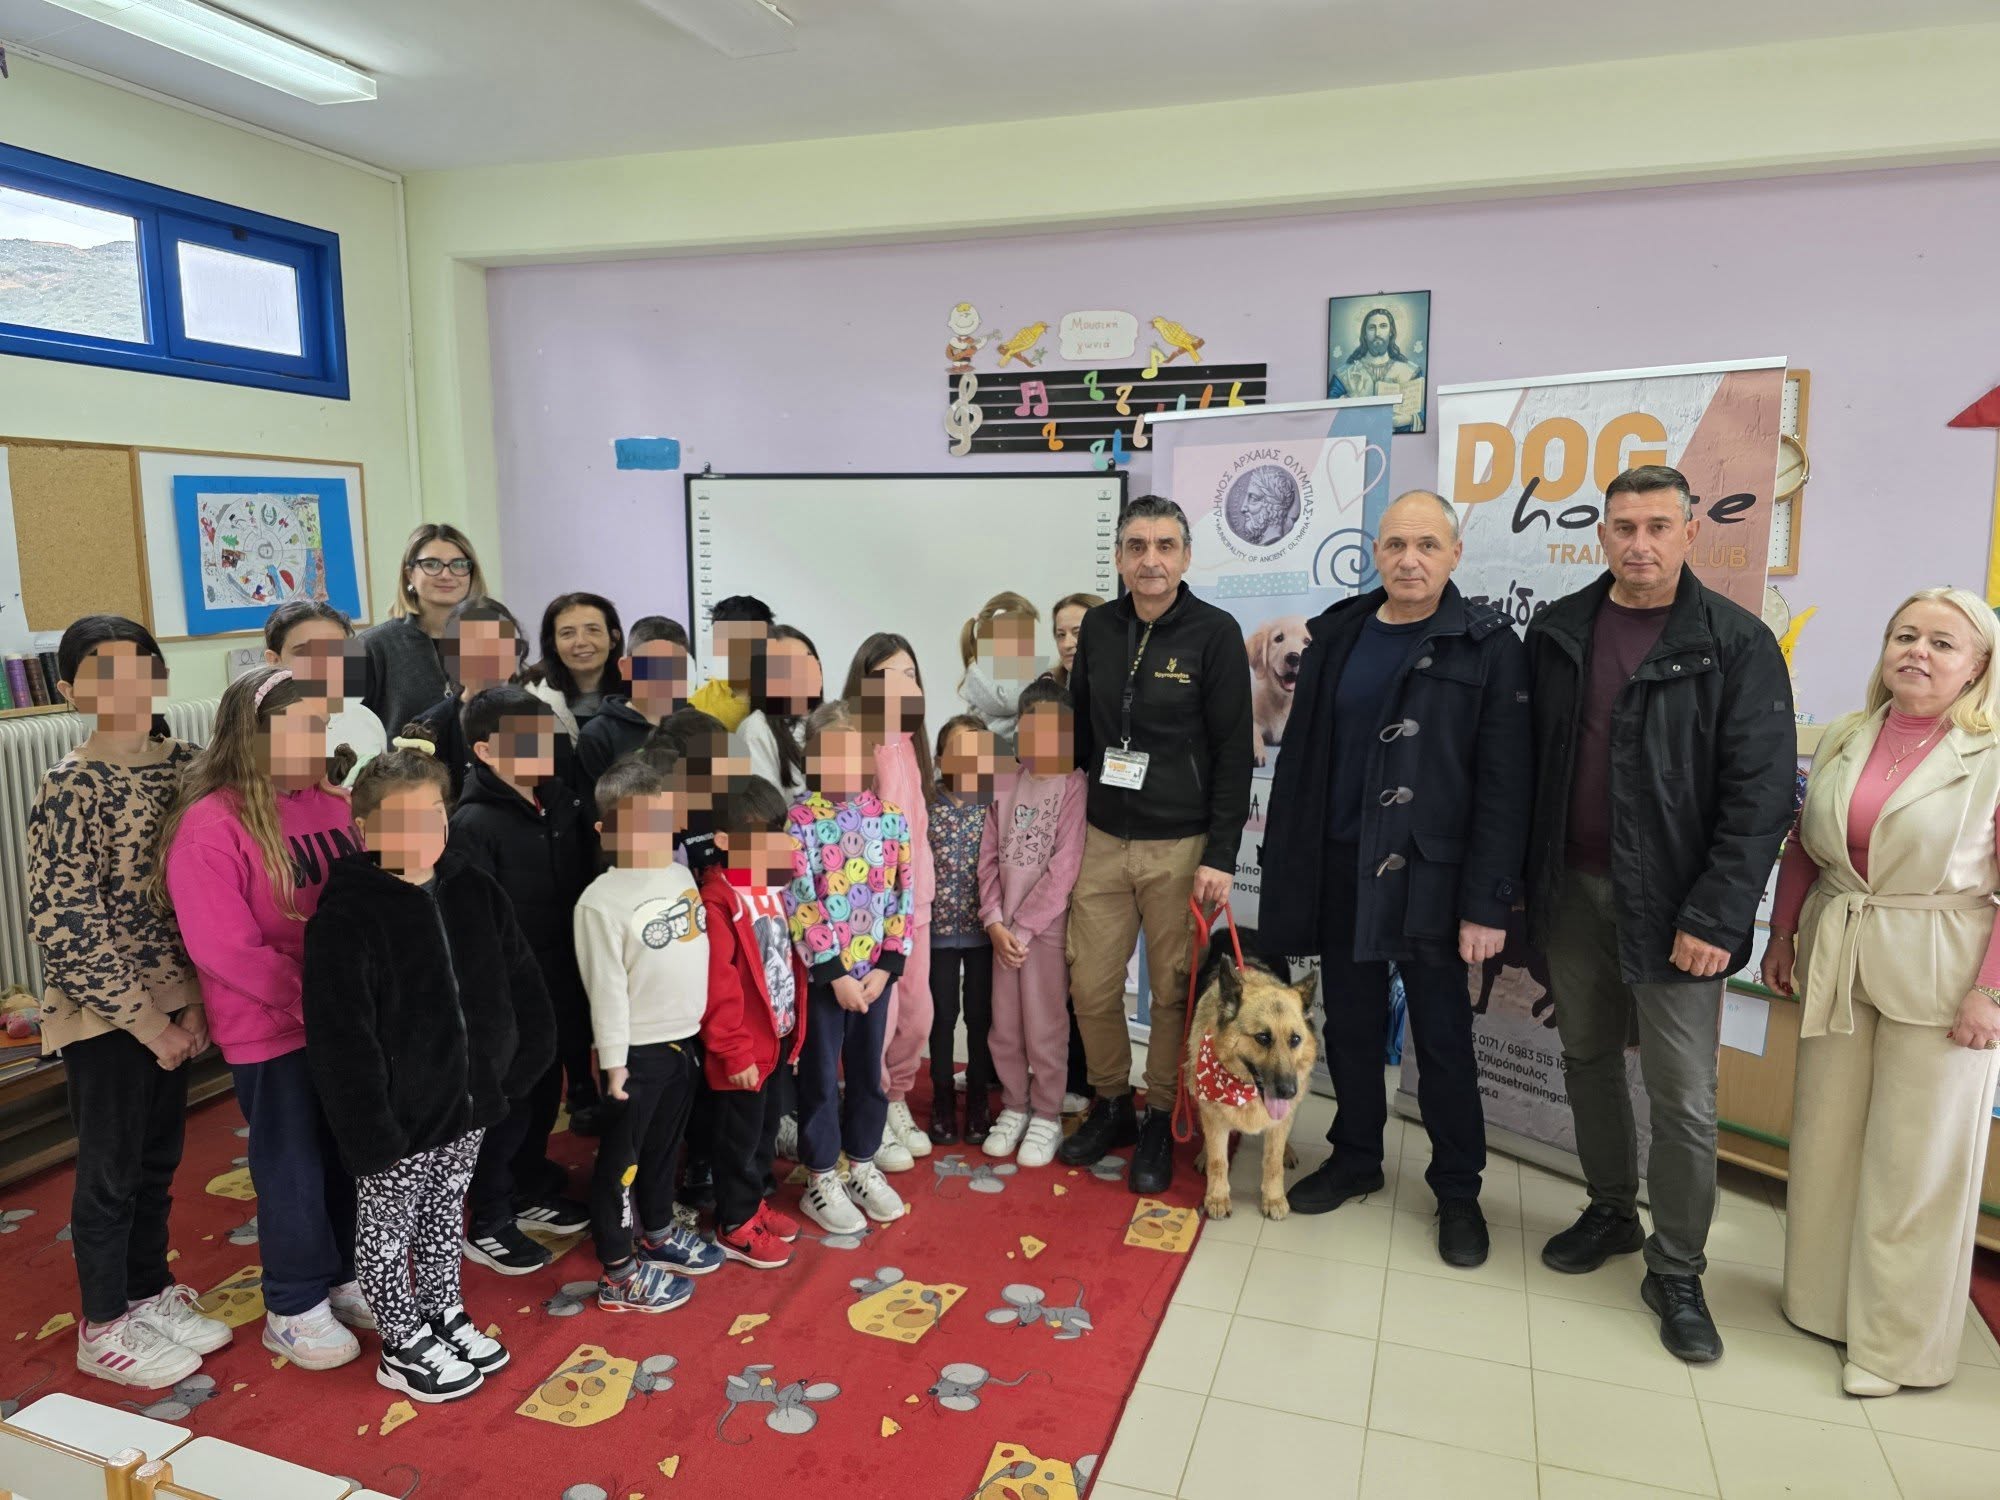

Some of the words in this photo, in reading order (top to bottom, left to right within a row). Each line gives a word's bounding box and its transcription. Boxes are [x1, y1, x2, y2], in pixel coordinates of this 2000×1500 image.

[1077, 338, 1111, 354] γωνιά
[1453, 412, 1668, 503] DOG
[1213, 471, 1233, 517] ΔΗΜΟΣ
[1233, 448, 1281, 472] ΑΡΧΑΙΑΣ
[1284, 455, 1314, 516] ΟΛΥΜΠΙΑΣ
[1512, 476, 1757, 533] hoe
[1215, 523, 1248, 560] MUNICIPALITY
[1248, 554, 1258, 563] OF
[1260, 548, 1287, 563] ANCIENT
[1287, 521, 1311, 551] OLYMPIA
[1547, 543, 1608, 566] TRAI
[1690, 542, 1747, 570] LUB
[1233, 882, 1260, 894] ποτα
[1477, 1050, 1548, 1084] Σπυρόπουλος
[1479, 1034, 1499, 1050] 0171
[1507, 1043, 1535, 1061] 6983
[1536, 1052, 1554, 1067] 515
[1556, 1057, 1568, 1070] 16
